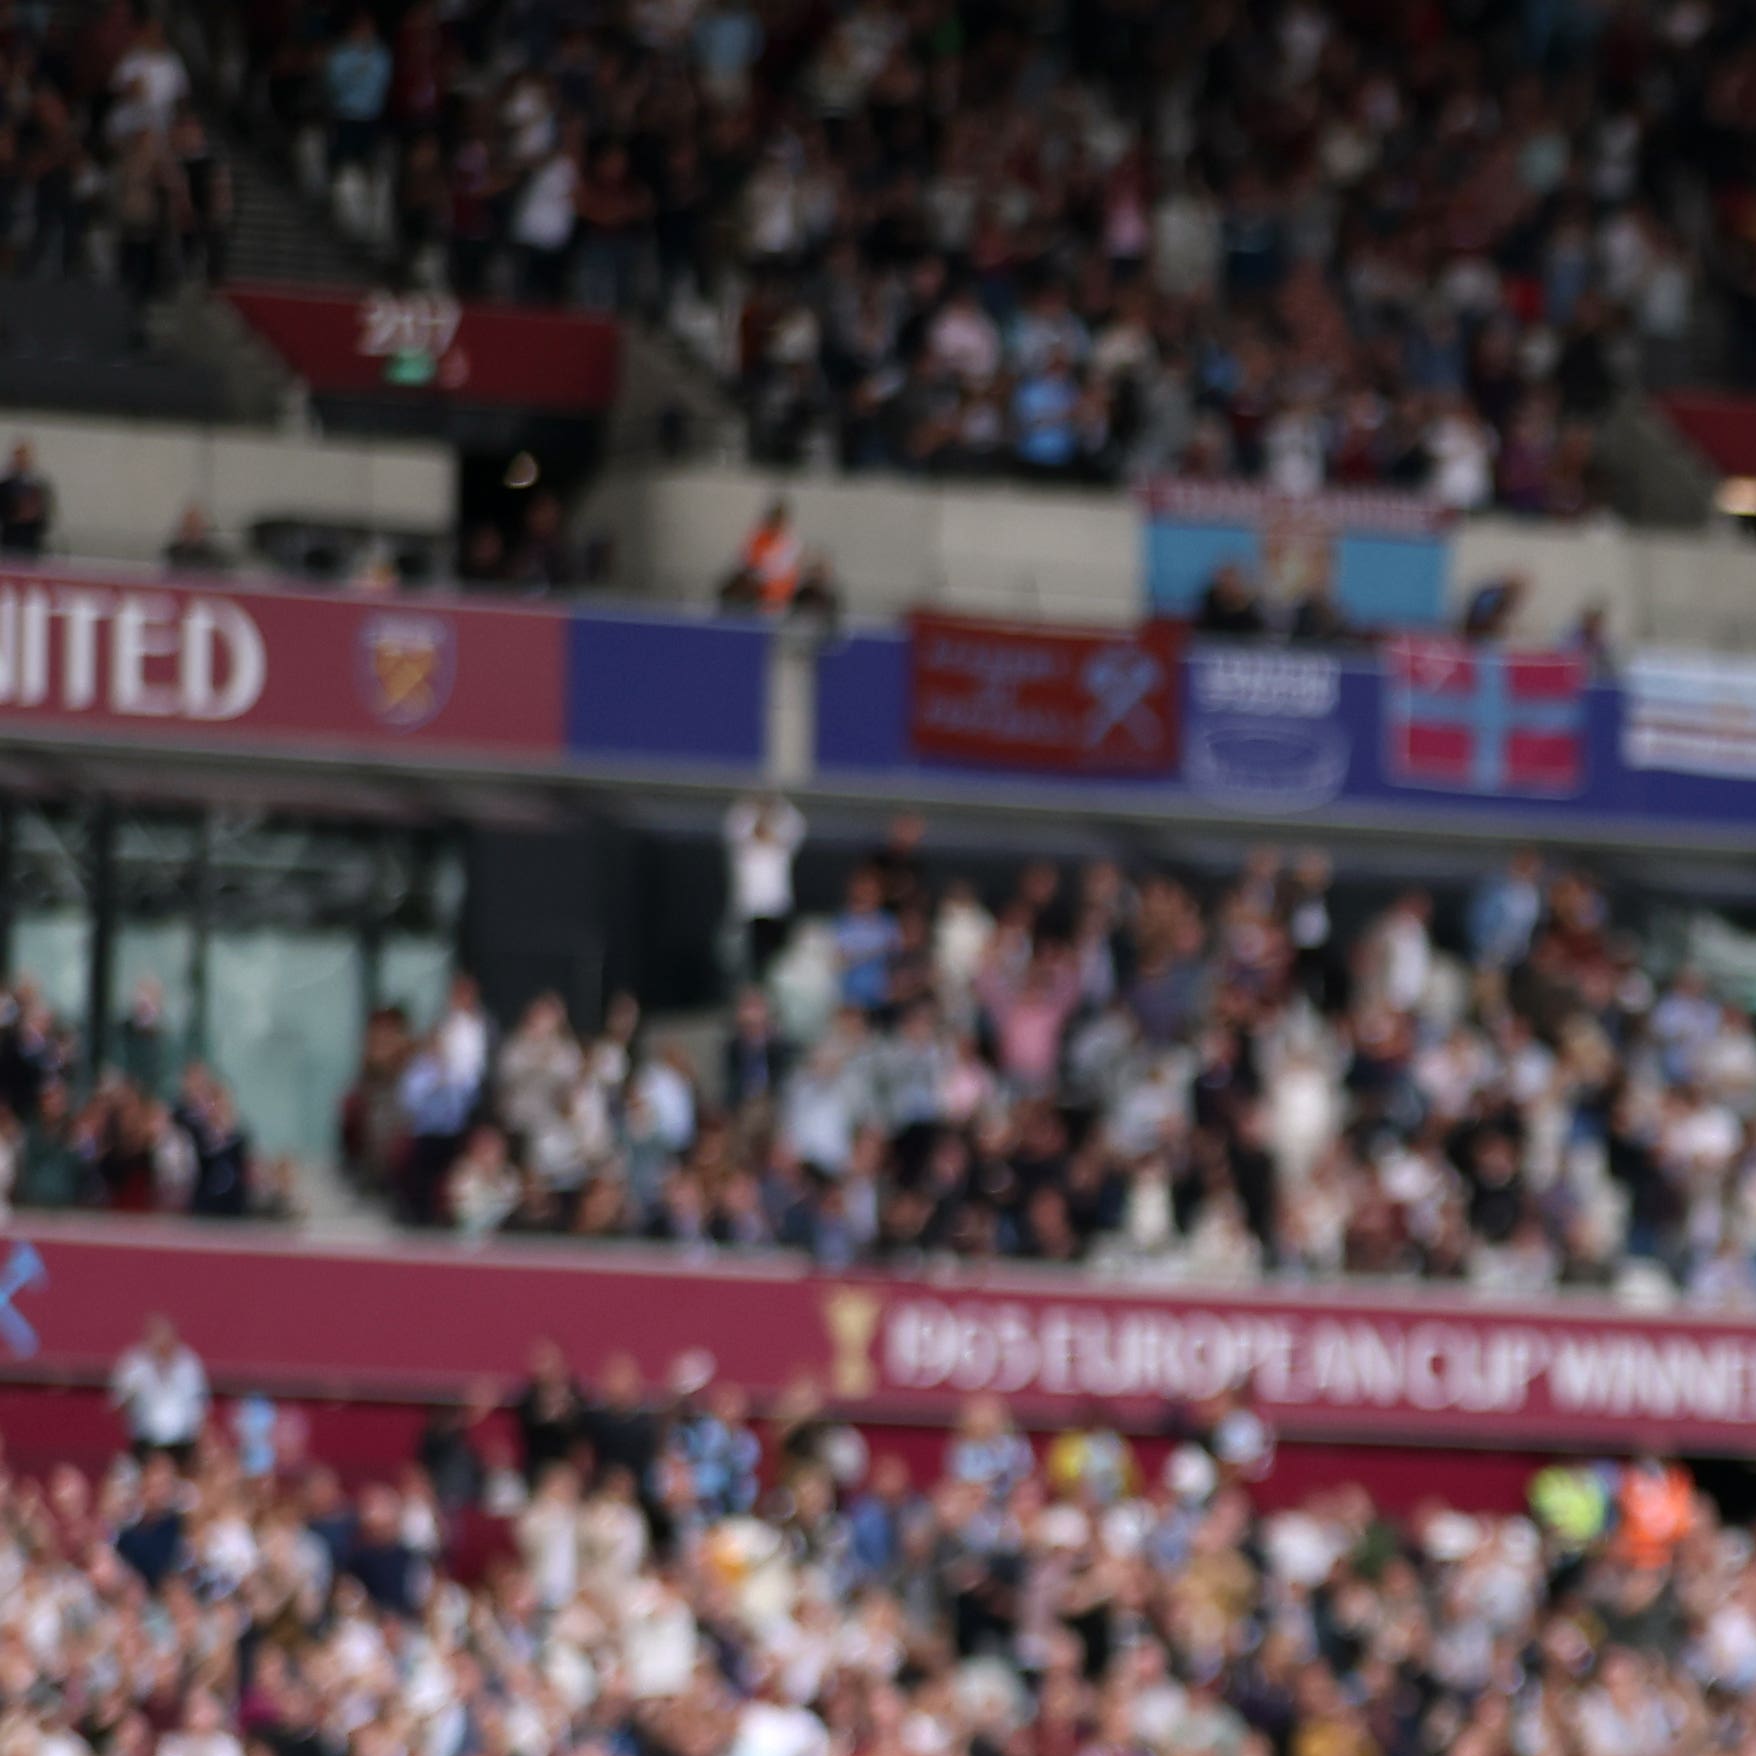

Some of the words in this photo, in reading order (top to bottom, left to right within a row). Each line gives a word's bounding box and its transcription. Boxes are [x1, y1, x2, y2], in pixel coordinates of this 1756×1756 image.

[0, 584, 268, 722] ITED
[1042, 1304, 1404, 1406] EUROPEAN
[1404, 1320, 1548, 1414] CUP
